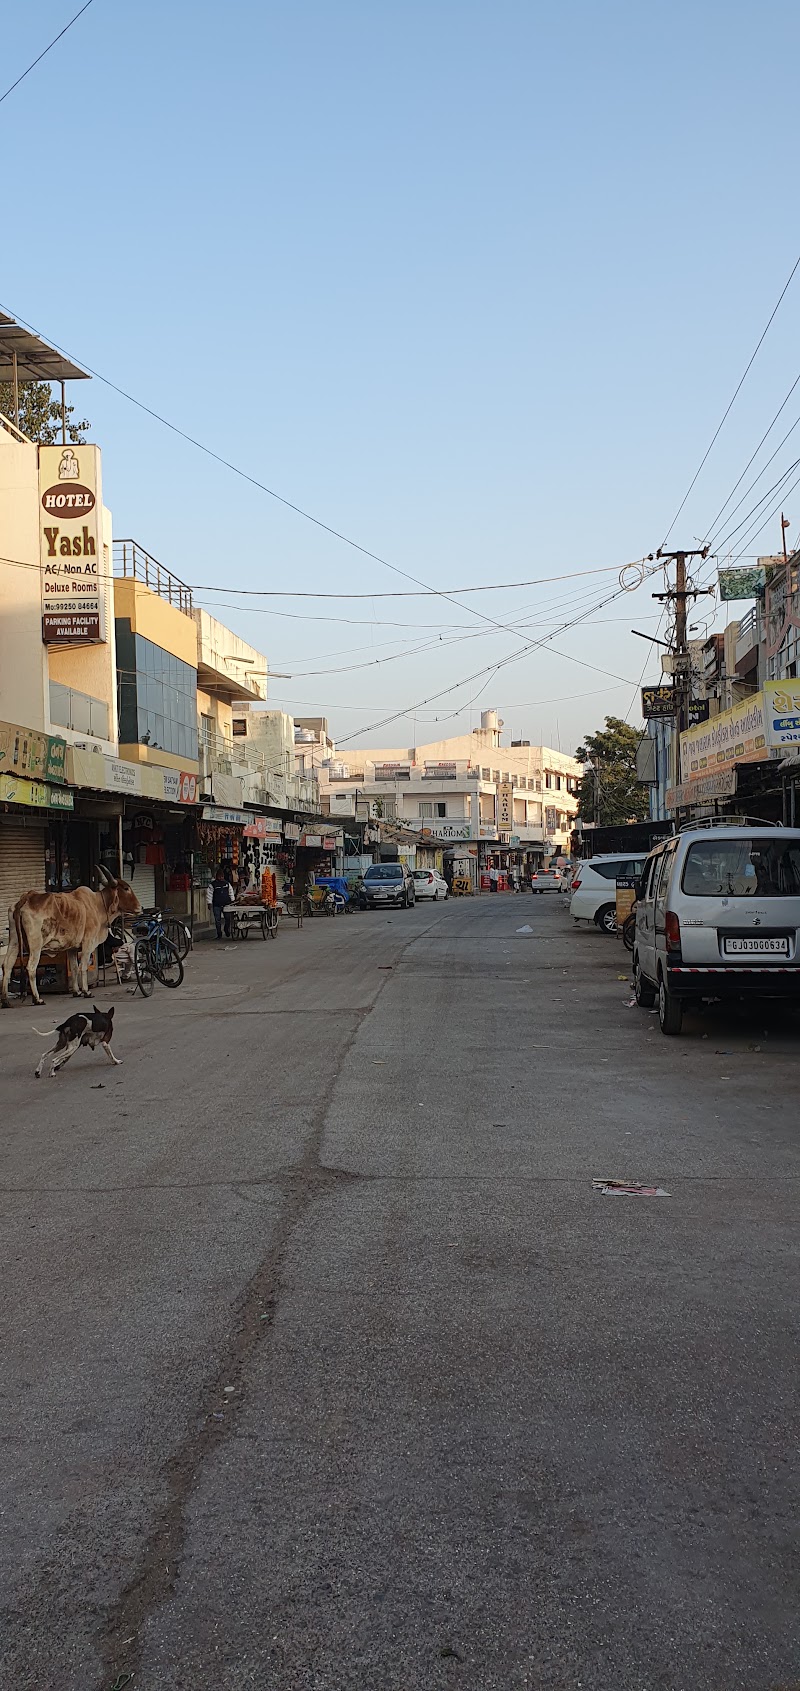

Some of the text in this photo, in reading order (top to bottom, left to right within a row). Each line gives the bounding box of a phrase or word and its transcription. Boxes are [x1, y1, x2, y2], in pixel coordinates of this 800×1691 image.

[45, 493, 93, 508] HOTEL
[44, 526, 96, 557] Yash
[64, 563, 82, 574] Non
[84, 563, 97, 574] AC
[45, 581, 98, 593] Deluxe Rooms
[45, 616, 99, 626] PARKING FACILITY
[56, 627, 88, 636] AVAILABLE
[501, 793, 509, 822] HARIOM
[732, 940, 786, 950] GJ03DG0634
